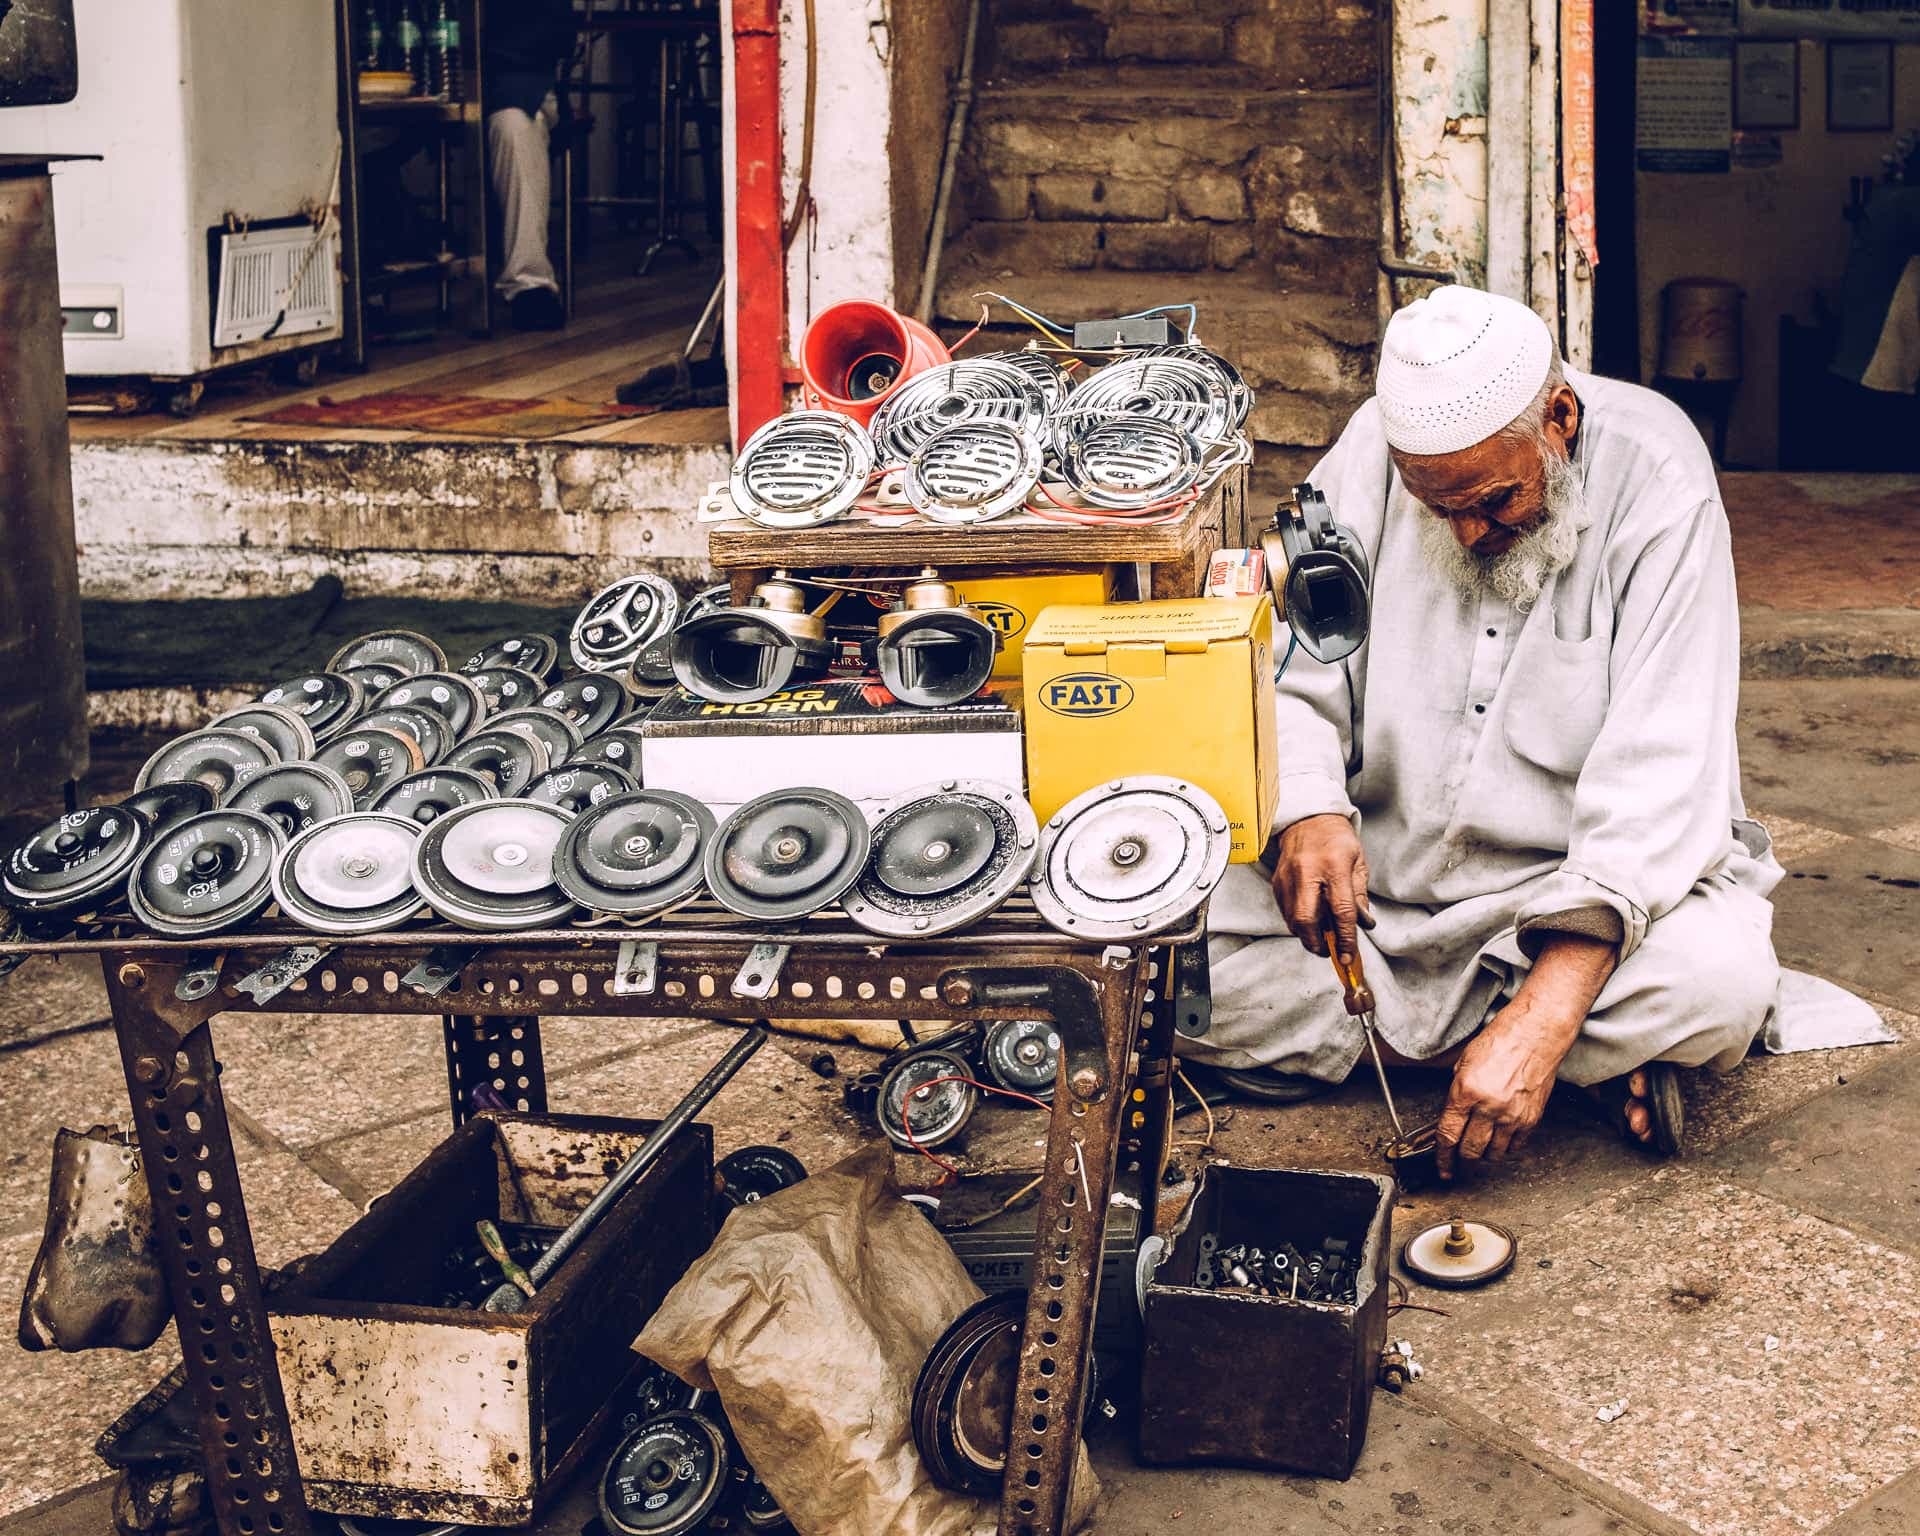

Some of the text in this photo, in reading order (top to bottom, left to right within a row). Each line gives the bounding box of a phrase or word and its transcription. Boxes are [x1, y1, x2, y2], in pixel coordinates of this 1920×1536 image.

[986, 612, 1014, 631] ST
[765, 690, 825, 703] OG
[1050, 684, 1122, 706] FAST
[700, 699, 840, 716] HORN
